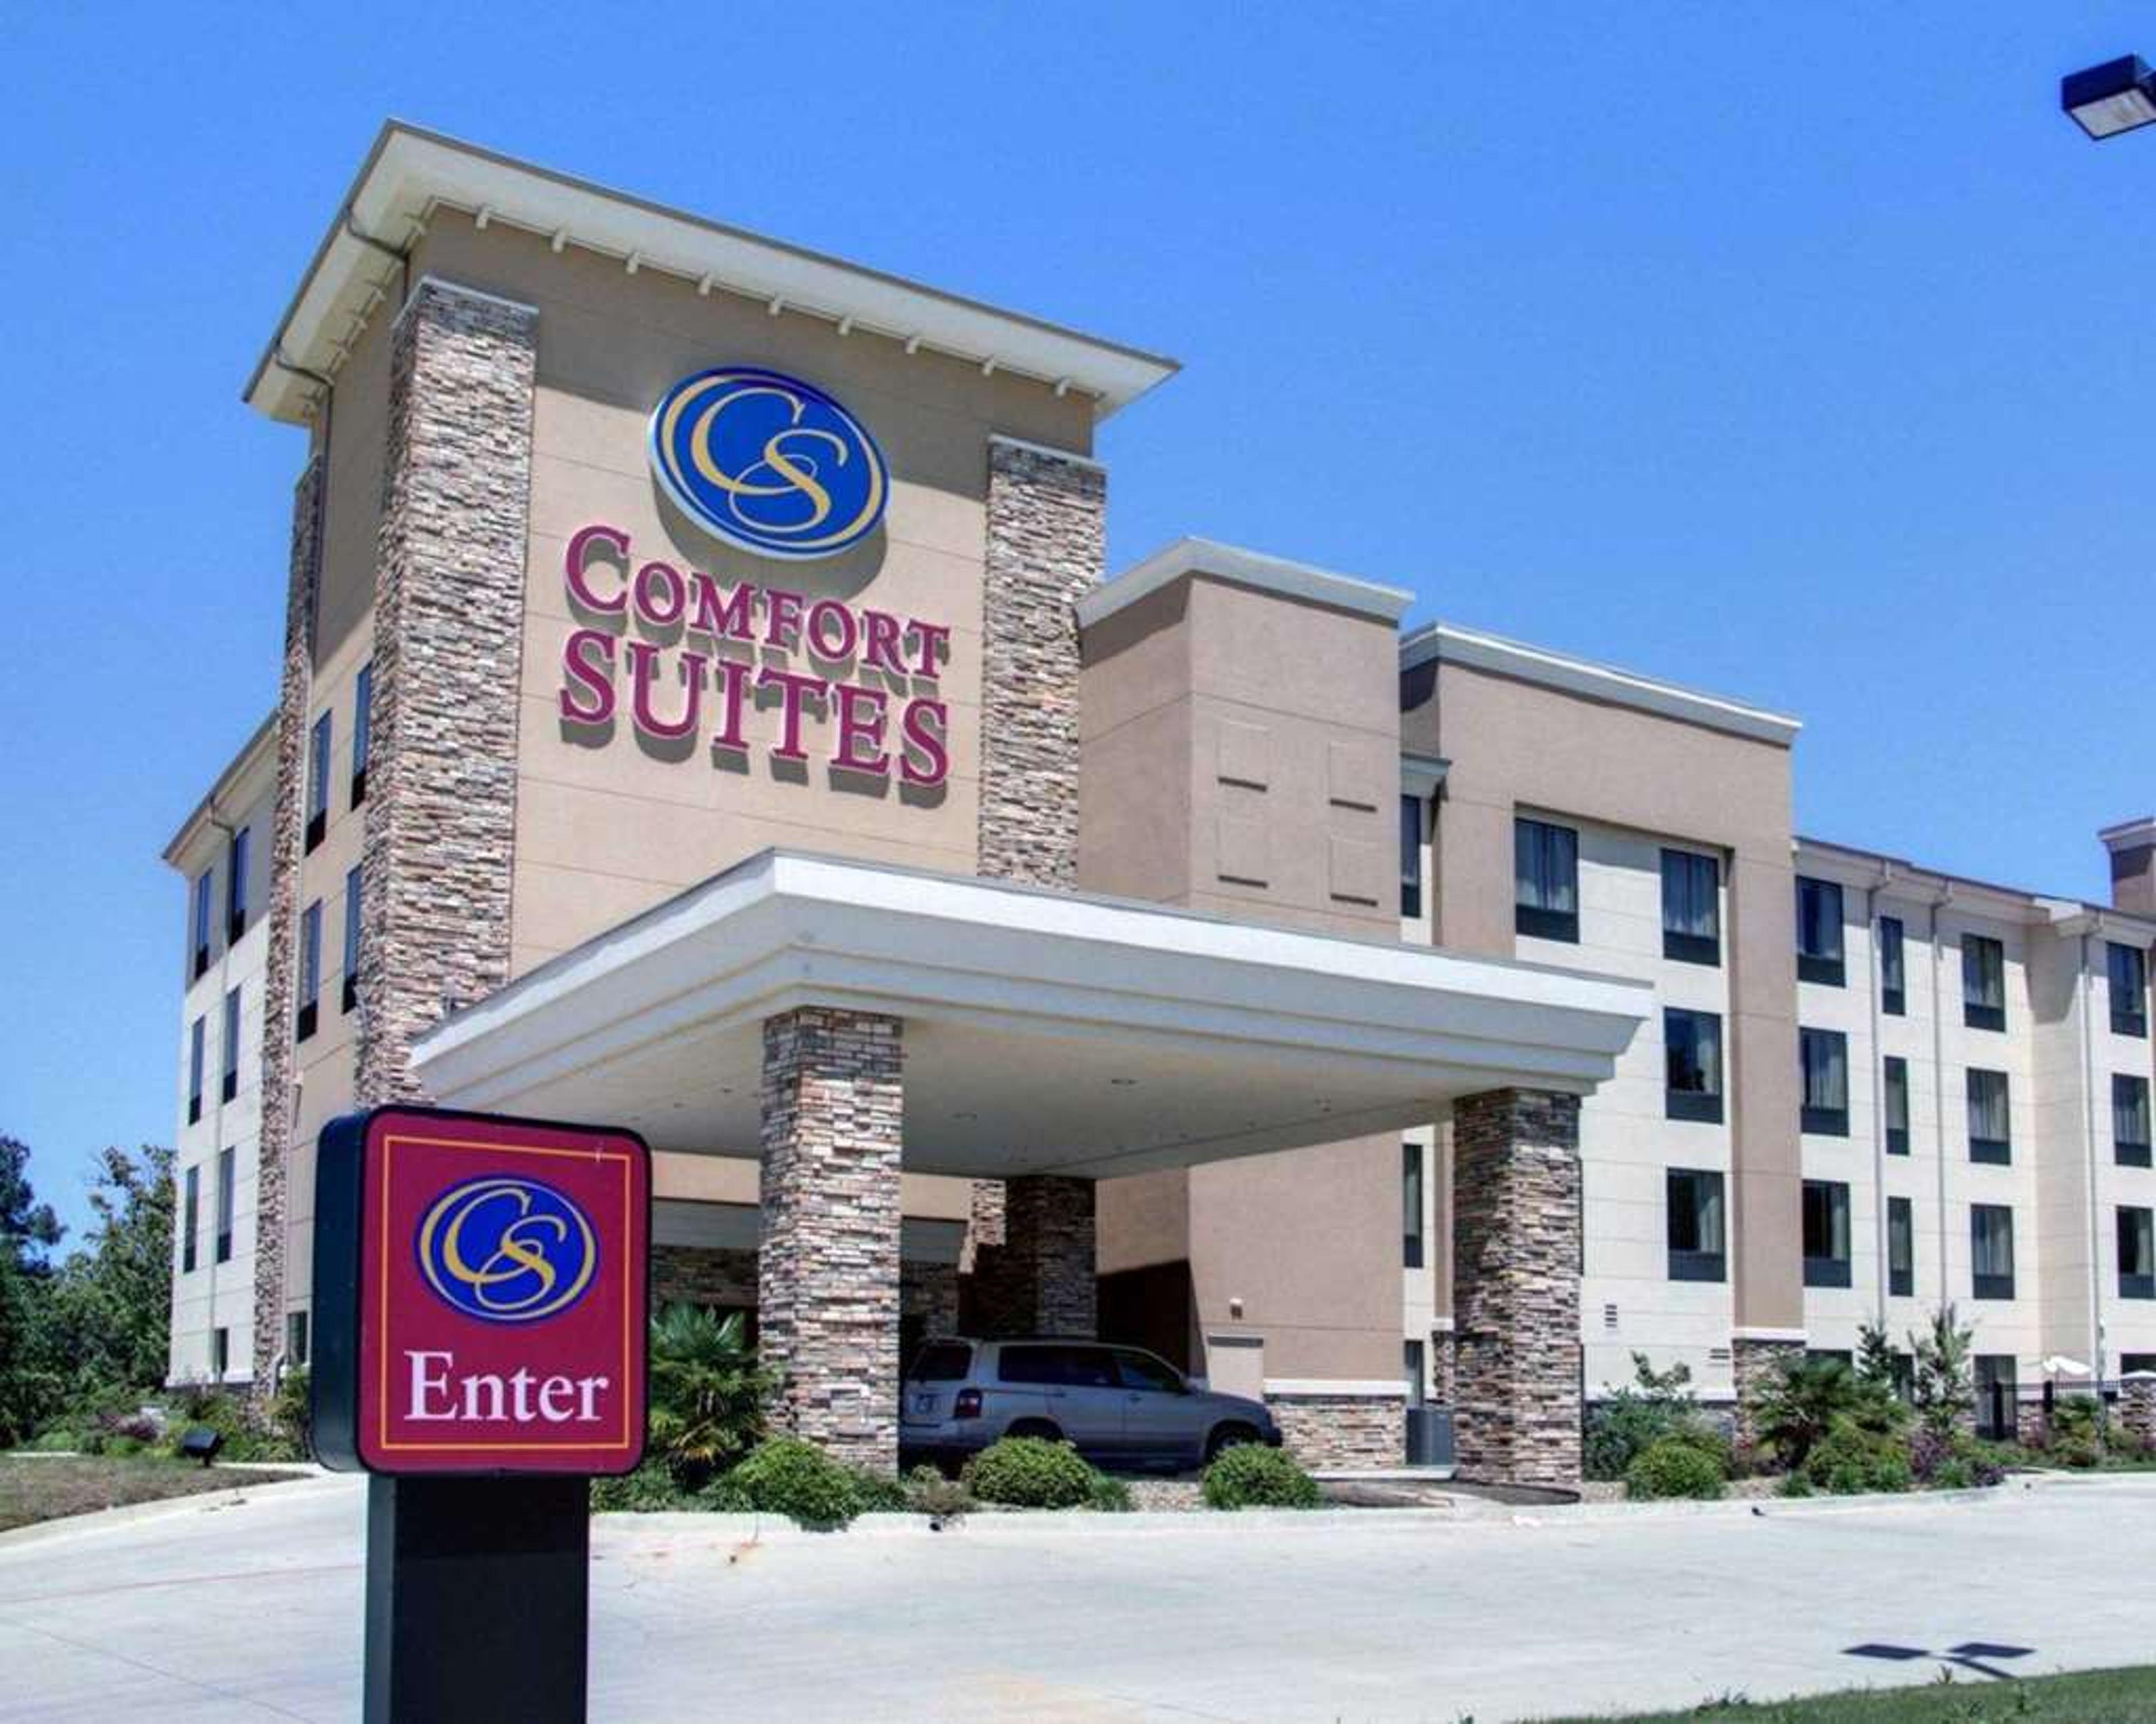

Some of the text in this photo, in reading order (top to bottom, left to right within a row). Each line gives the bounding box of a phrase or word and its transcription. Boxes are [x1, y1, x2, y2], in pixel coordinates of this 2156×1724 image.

[565, 525, 950, 678] COMFORT
[560, 628, 948, 786] SUITES
[404, 1350, 609, 1421] Enter
